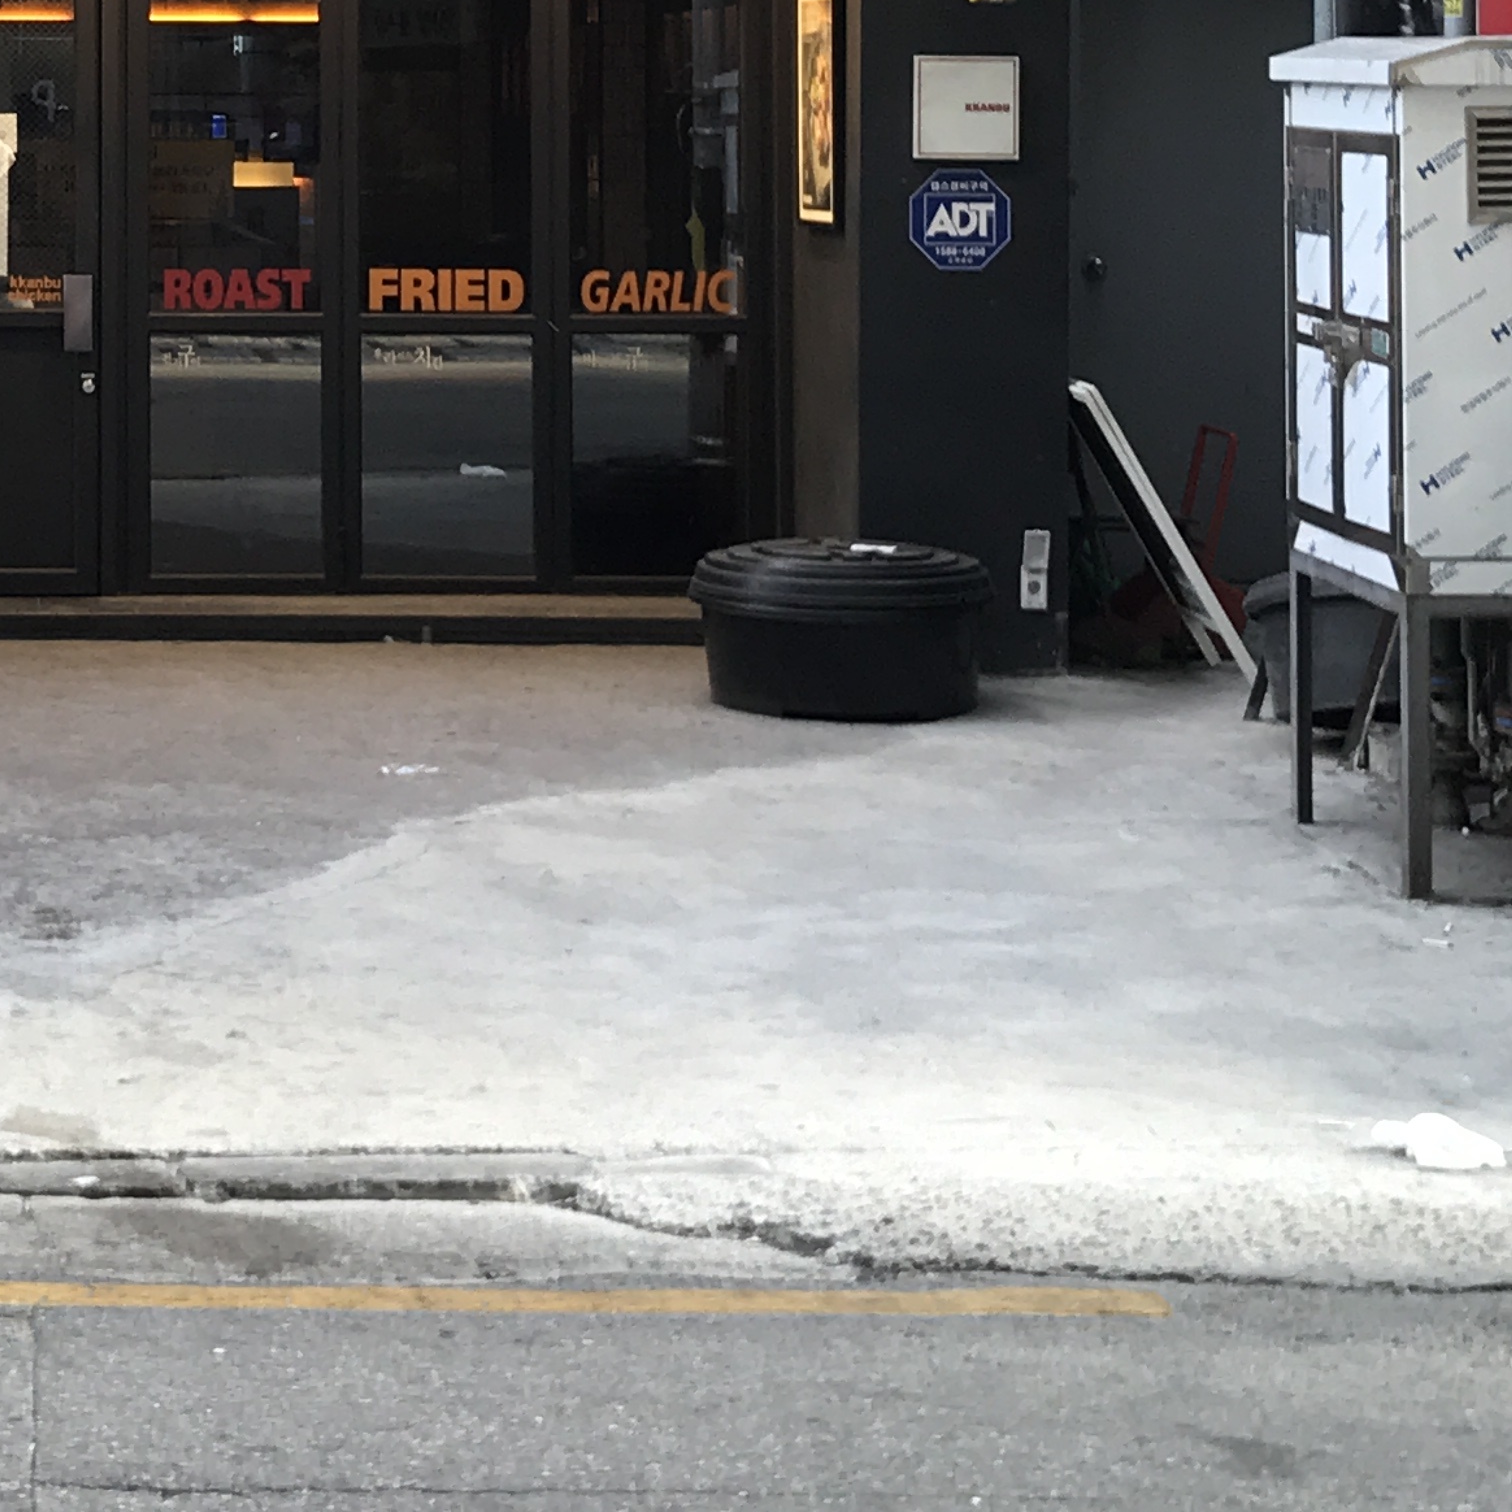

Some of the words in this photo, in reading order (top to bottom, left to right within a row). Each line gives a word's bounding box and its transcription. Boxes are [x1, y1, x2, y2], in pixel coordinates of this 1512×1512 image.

[926, 201, 995, 237] ADT
[163, 268, 312, 311] ROAST
[368, 268, 525, 312] FRIED
[580, 270, 736, 315] GARLIC
